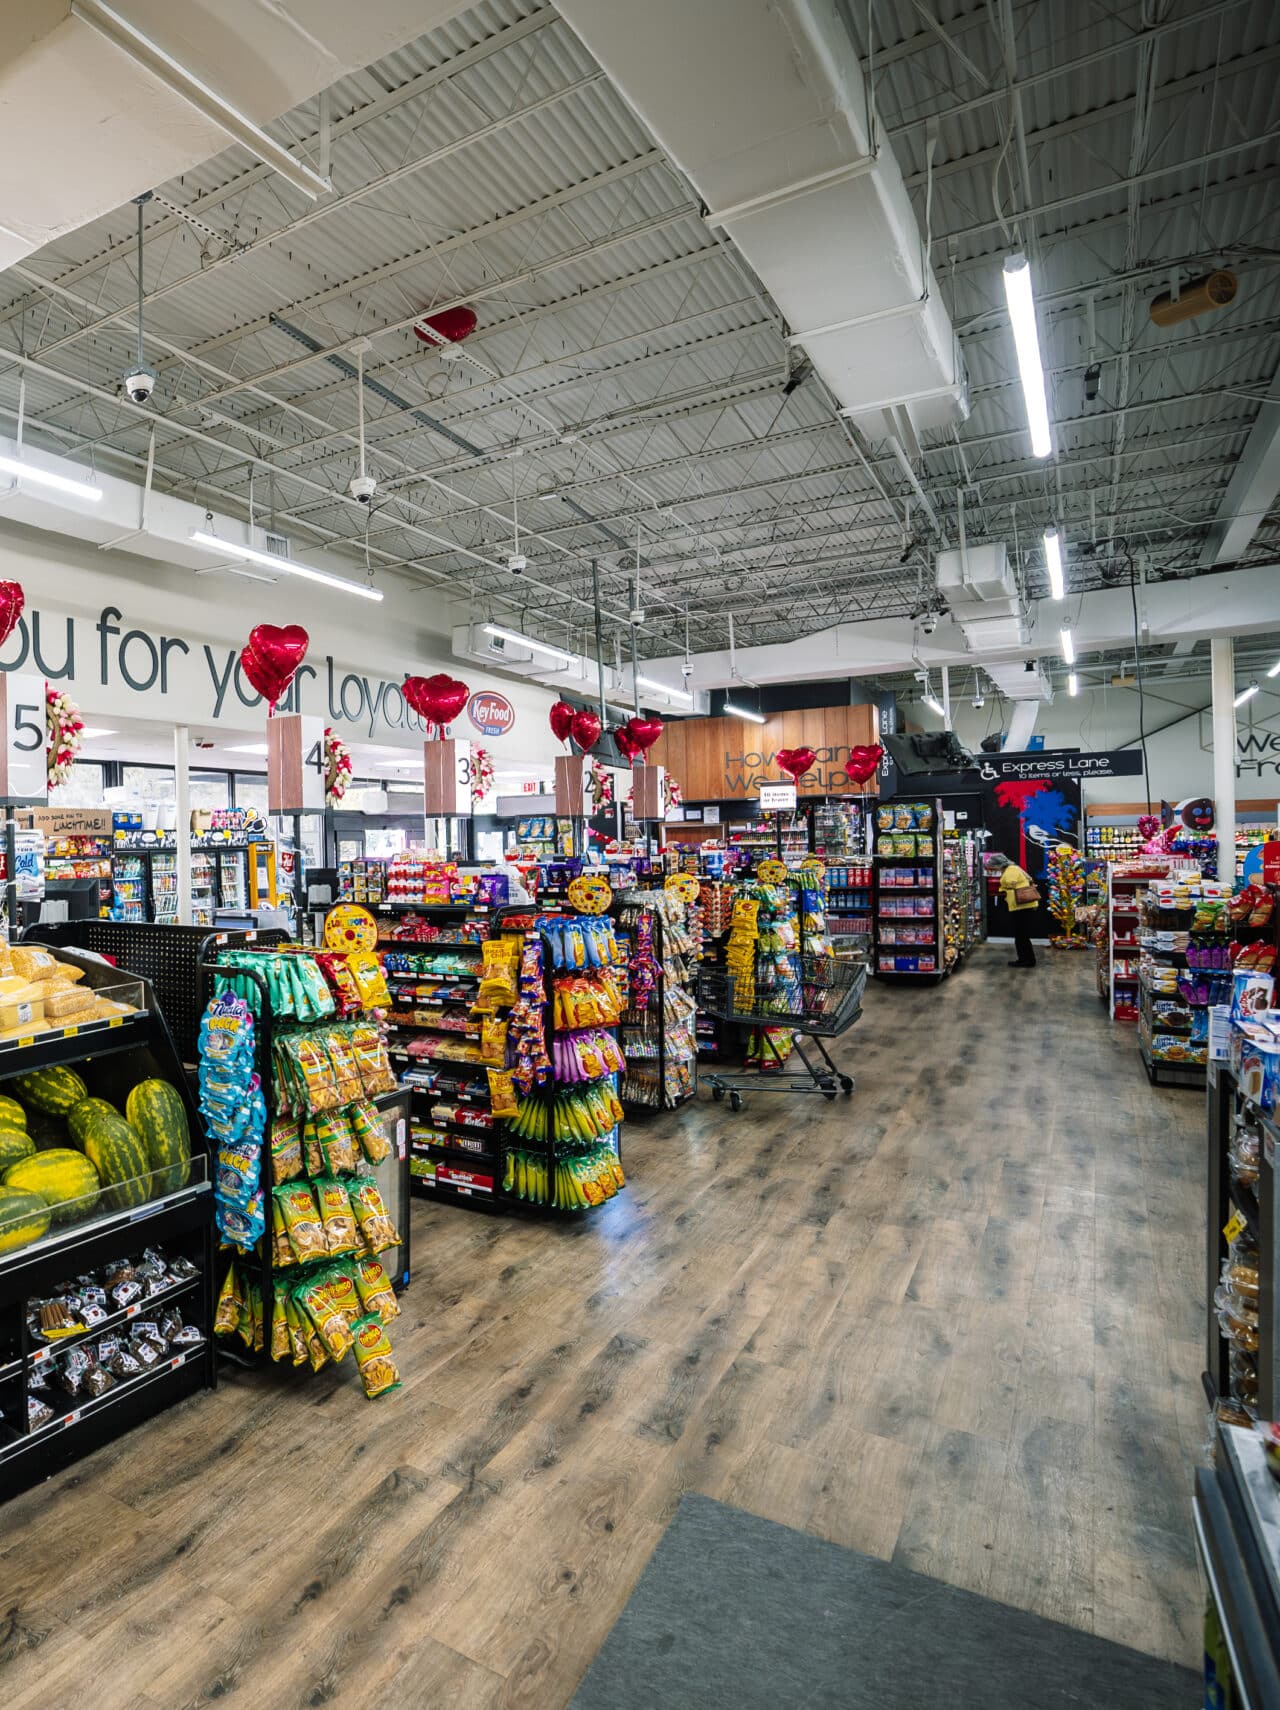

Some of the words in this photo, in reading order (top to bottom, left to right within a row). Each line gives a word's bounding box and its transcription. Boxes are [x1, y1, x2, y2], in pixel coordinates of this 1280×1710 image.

[96, 606, 189, 694] for
[472, 699, 490, 723] Key
[489, 702, 510, 722] Food
[13, 704, 43, 751] 5
[485, 726, 500, 734] FRESH
[305, 740, 323, 774] 4
[1002, 760, 1065, 773] Express
[1069, 758, 1110, 769] Lane
[457, 758, 470, 785] 3
[584, 770, 593, 793] 2
[725, 773, 769, 792] We
[523, 782, 536, 792] EXIT
[660, 774, 664, 798] 1
